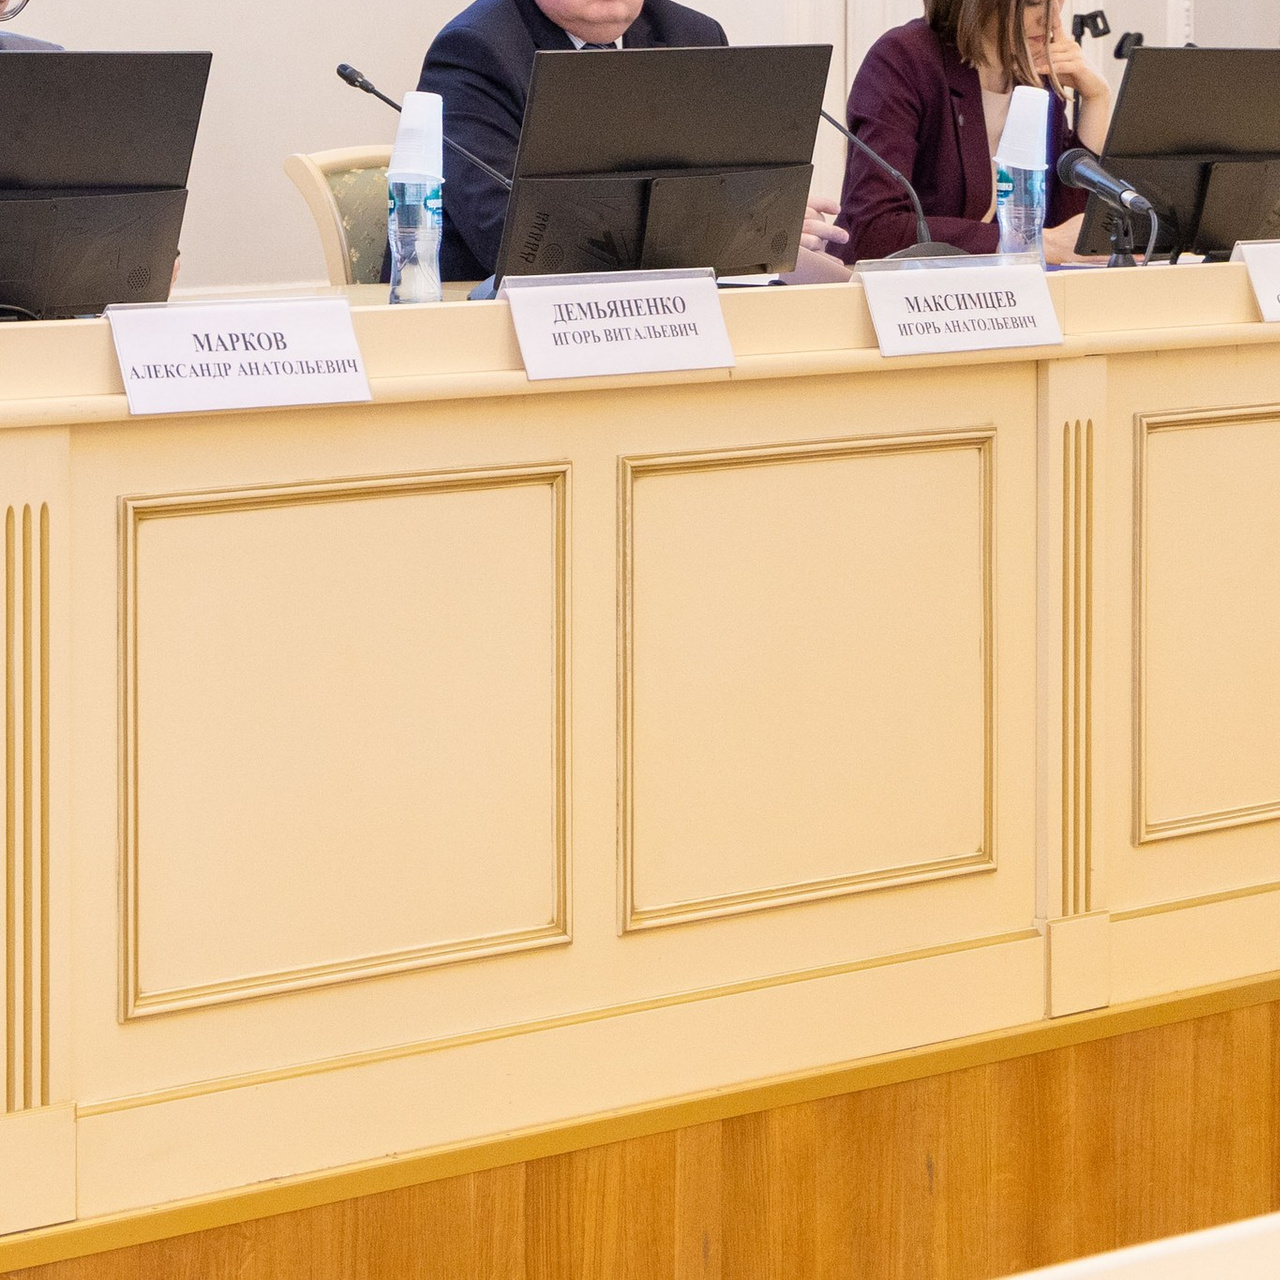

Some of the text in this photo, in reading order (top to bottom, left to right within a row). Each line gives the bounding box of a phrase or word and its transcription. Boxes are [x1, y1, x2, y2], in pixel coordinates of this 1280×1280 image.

[552, 295, 687, 325] ДЕМЬЯНЕНКО
[904, 290, 1018, 314] МАКСИМЦЕВ
[552, 322, 700, 346] ИГОРЬ ВИТАЛЬЕВИЧ
[897, 315, 1038, 337] ИГОРЬ АНАТОЛЬЕВИЧ
[192, 331, 288, 352] МАРКОВ
[129, 358, 359, 380] АЛЕКСАНДР АНАТОЛЬЕВИЧ
